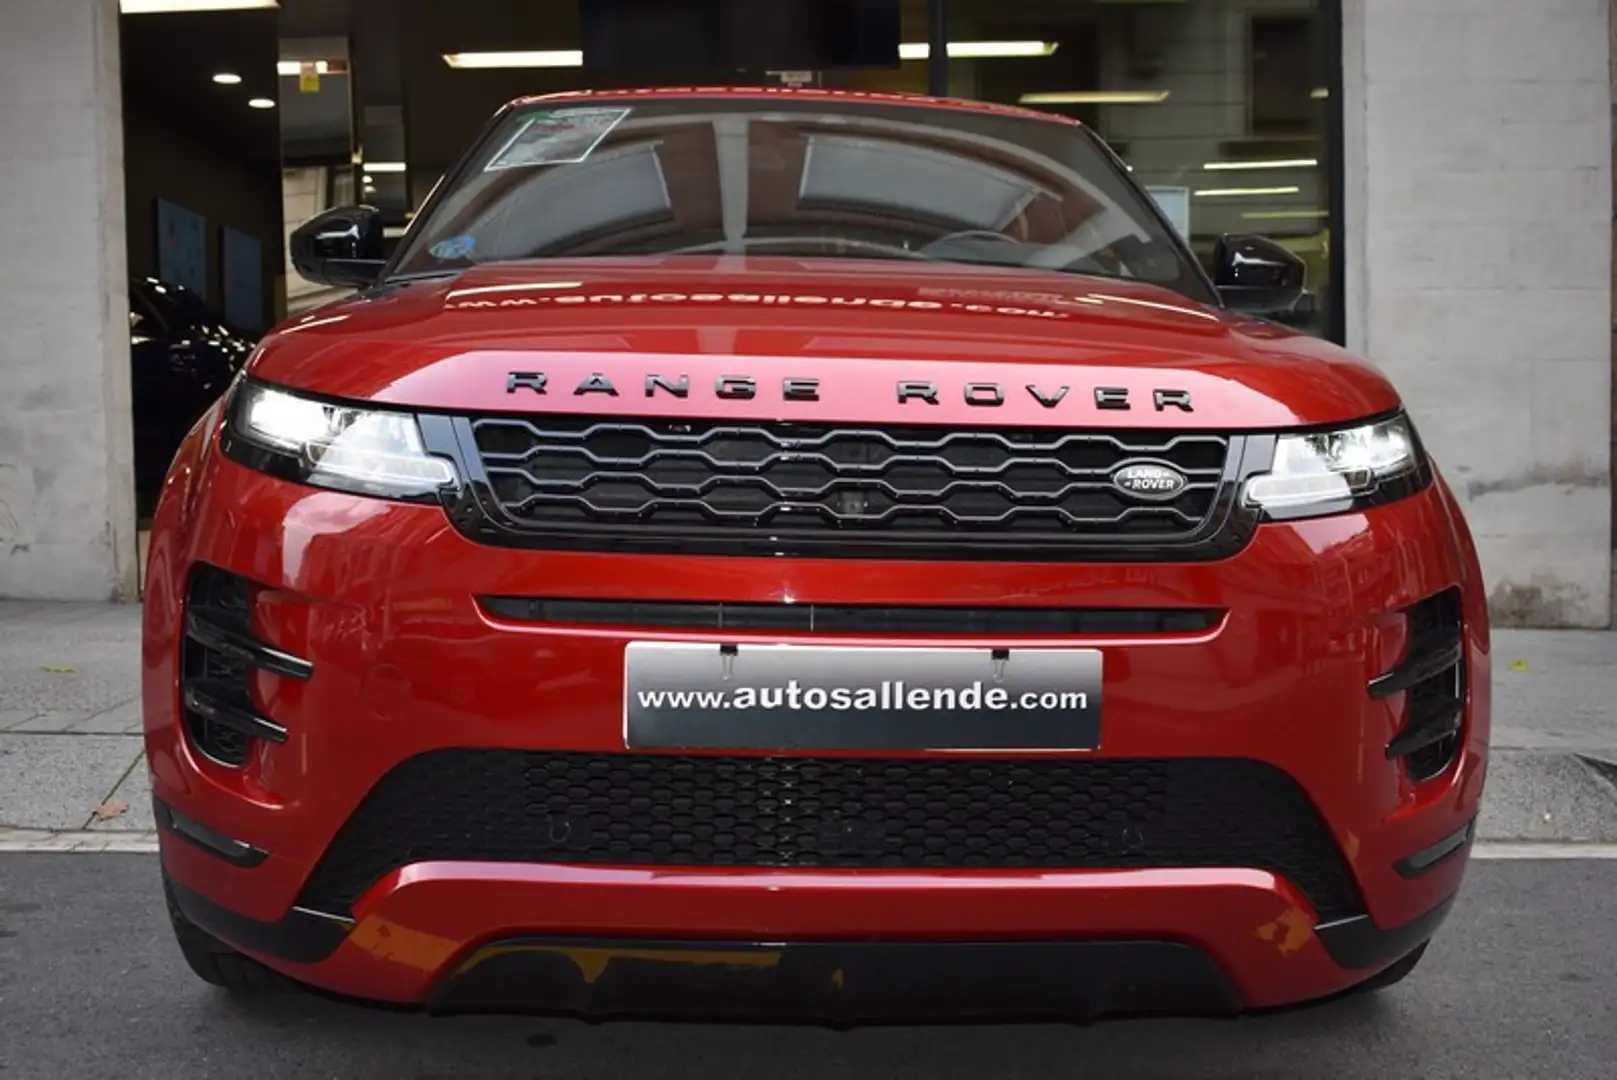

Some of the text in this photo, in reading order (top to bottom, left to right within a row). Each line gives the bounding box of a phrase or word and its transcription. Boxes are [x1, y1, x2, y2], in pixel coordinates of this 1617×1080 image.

[506, 371, 1194, 413] RANGE ROVER
[1127, 467, 1162, 479] LAND
[1132, 479, 1175, 491] ROVER
[637, 680, 1087, 709] www.autosallende.com
